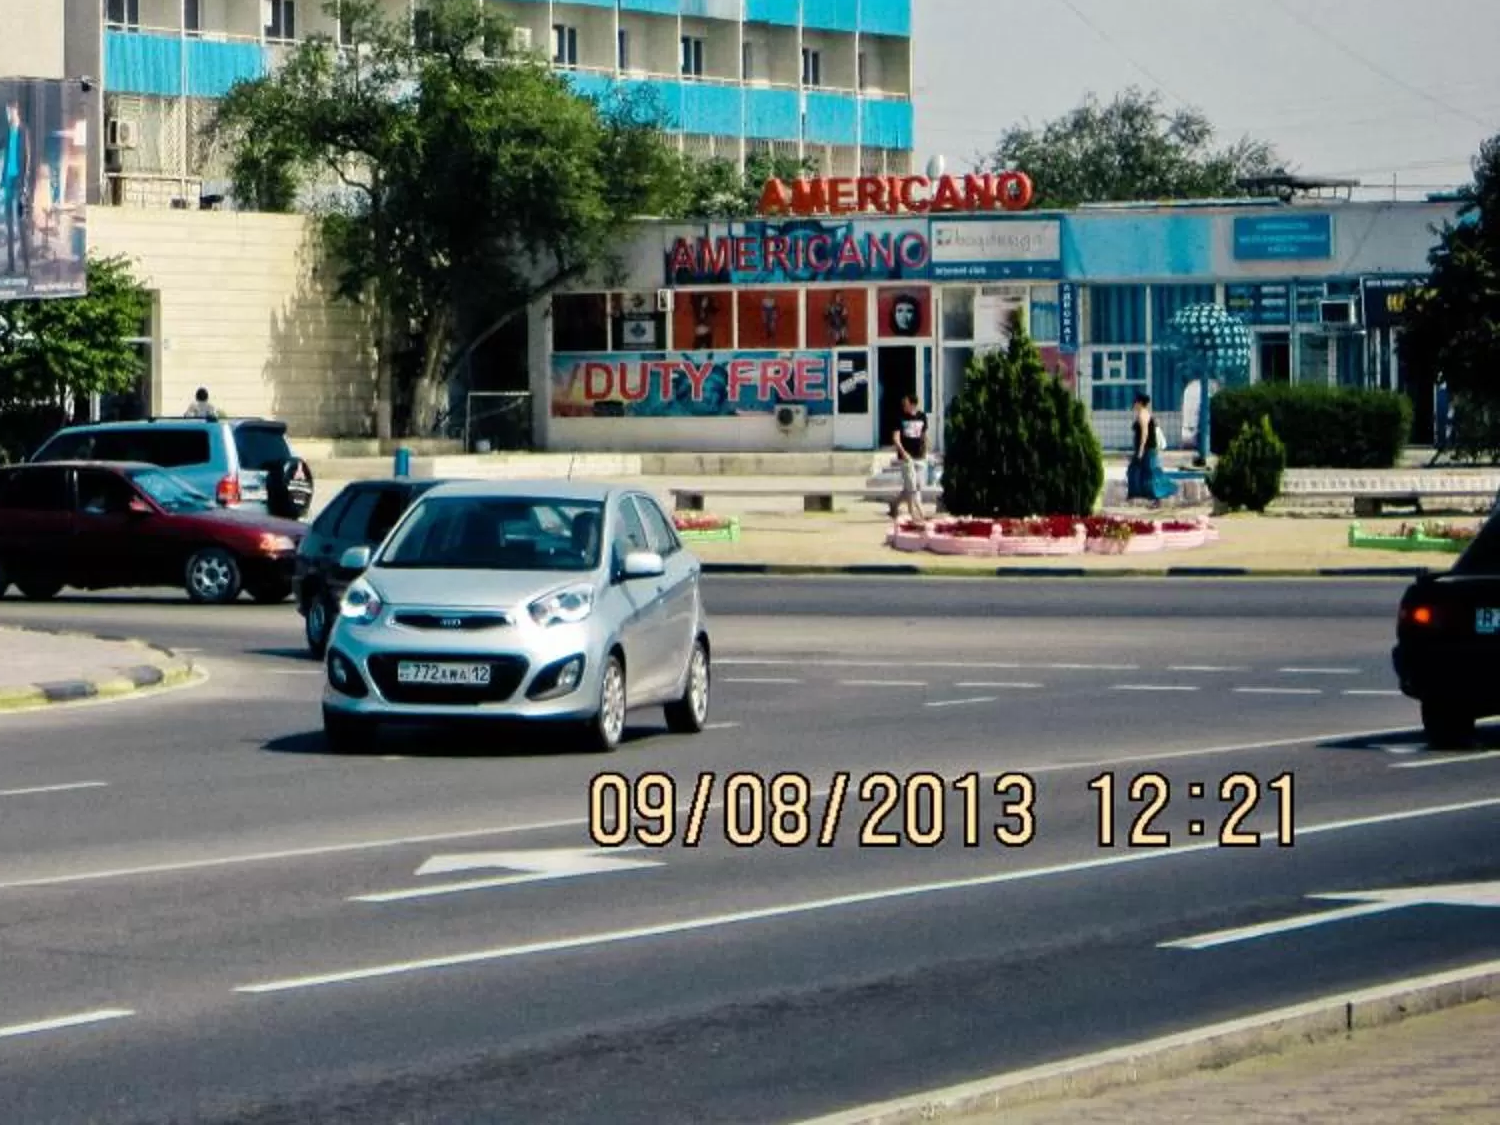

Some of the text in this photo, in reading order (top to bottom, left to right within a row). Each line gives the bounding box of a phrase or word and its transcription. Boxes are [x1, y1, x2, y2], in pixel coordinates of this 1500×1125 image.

[757, 171, 1033, 216] AMERICANO
[669, 228, 930, 274] AMERICANO
[582, 359, 714, 404] DUTY
[471, 665, 490, 682] 12
